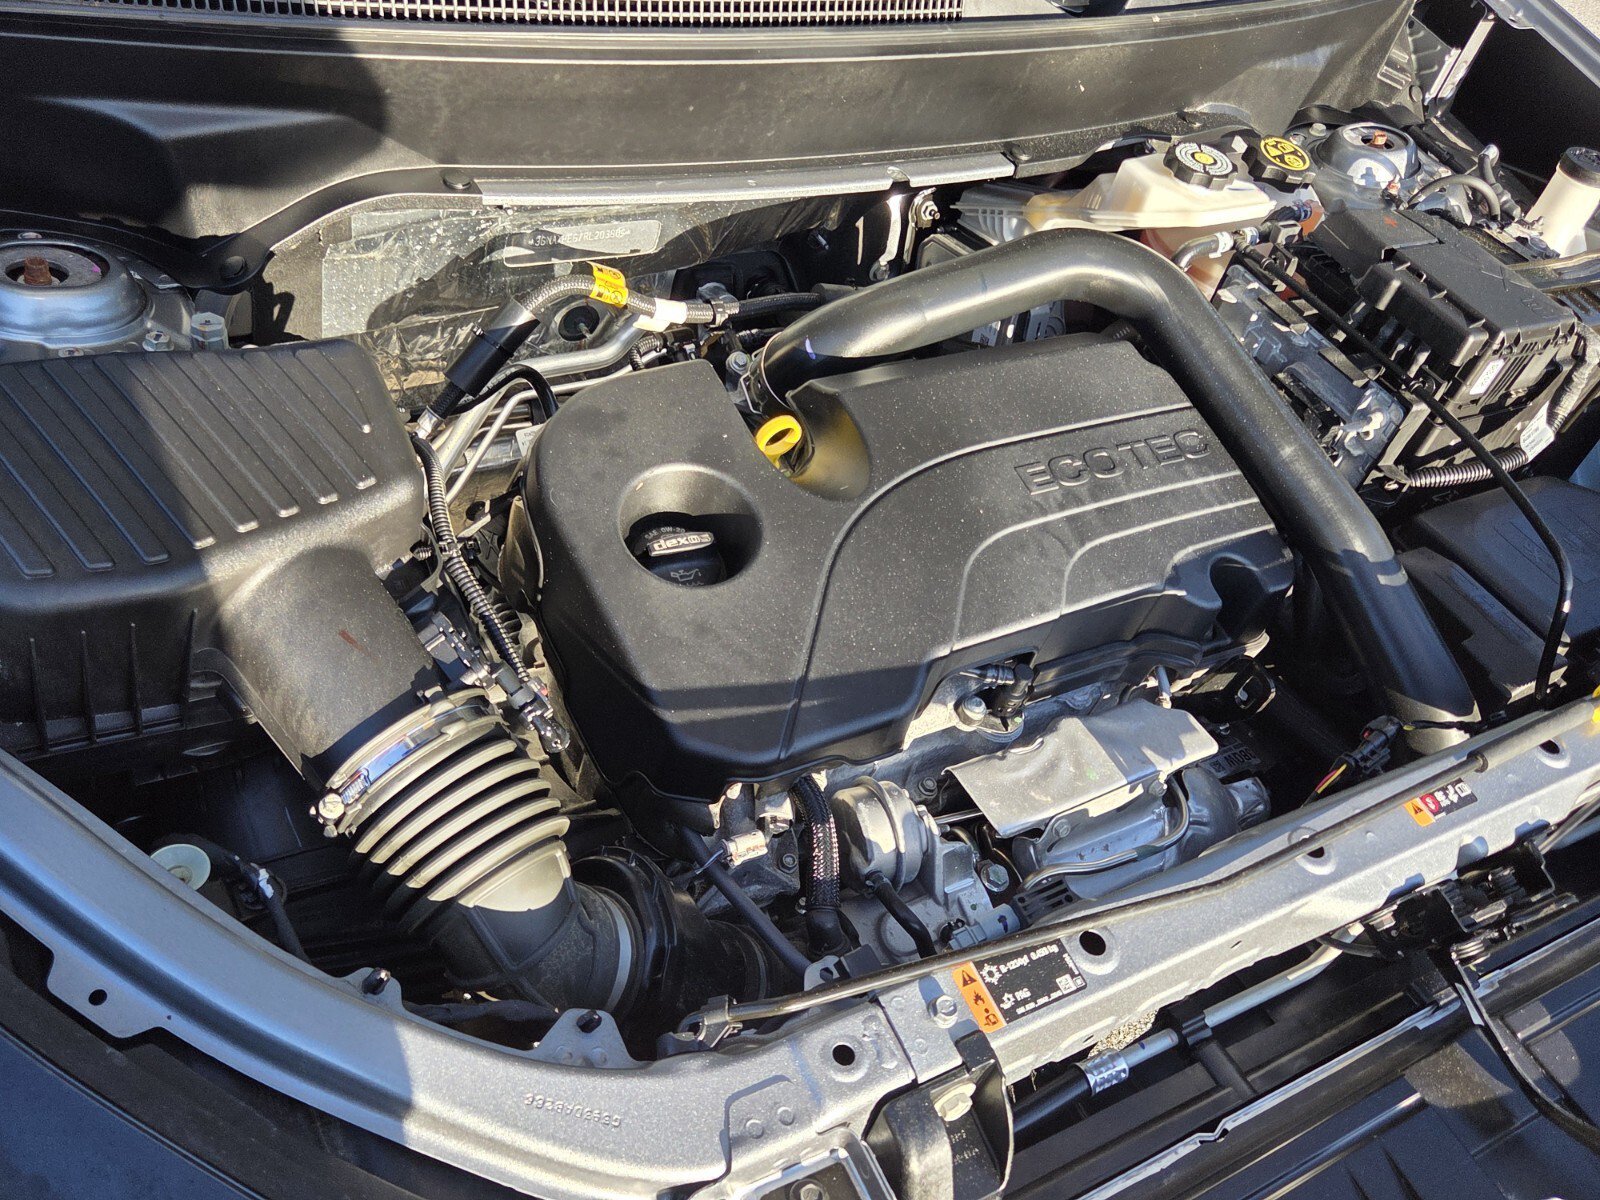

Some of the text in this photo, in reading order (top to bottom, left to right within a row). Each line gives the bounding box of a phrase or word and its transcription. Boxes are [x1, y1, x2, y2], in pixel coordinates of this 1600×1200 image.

[1013, 429, 1211, 496] ECOTEC
[644, 529, 659, 540] SAE
[652, 533, 712, 551] dexos
